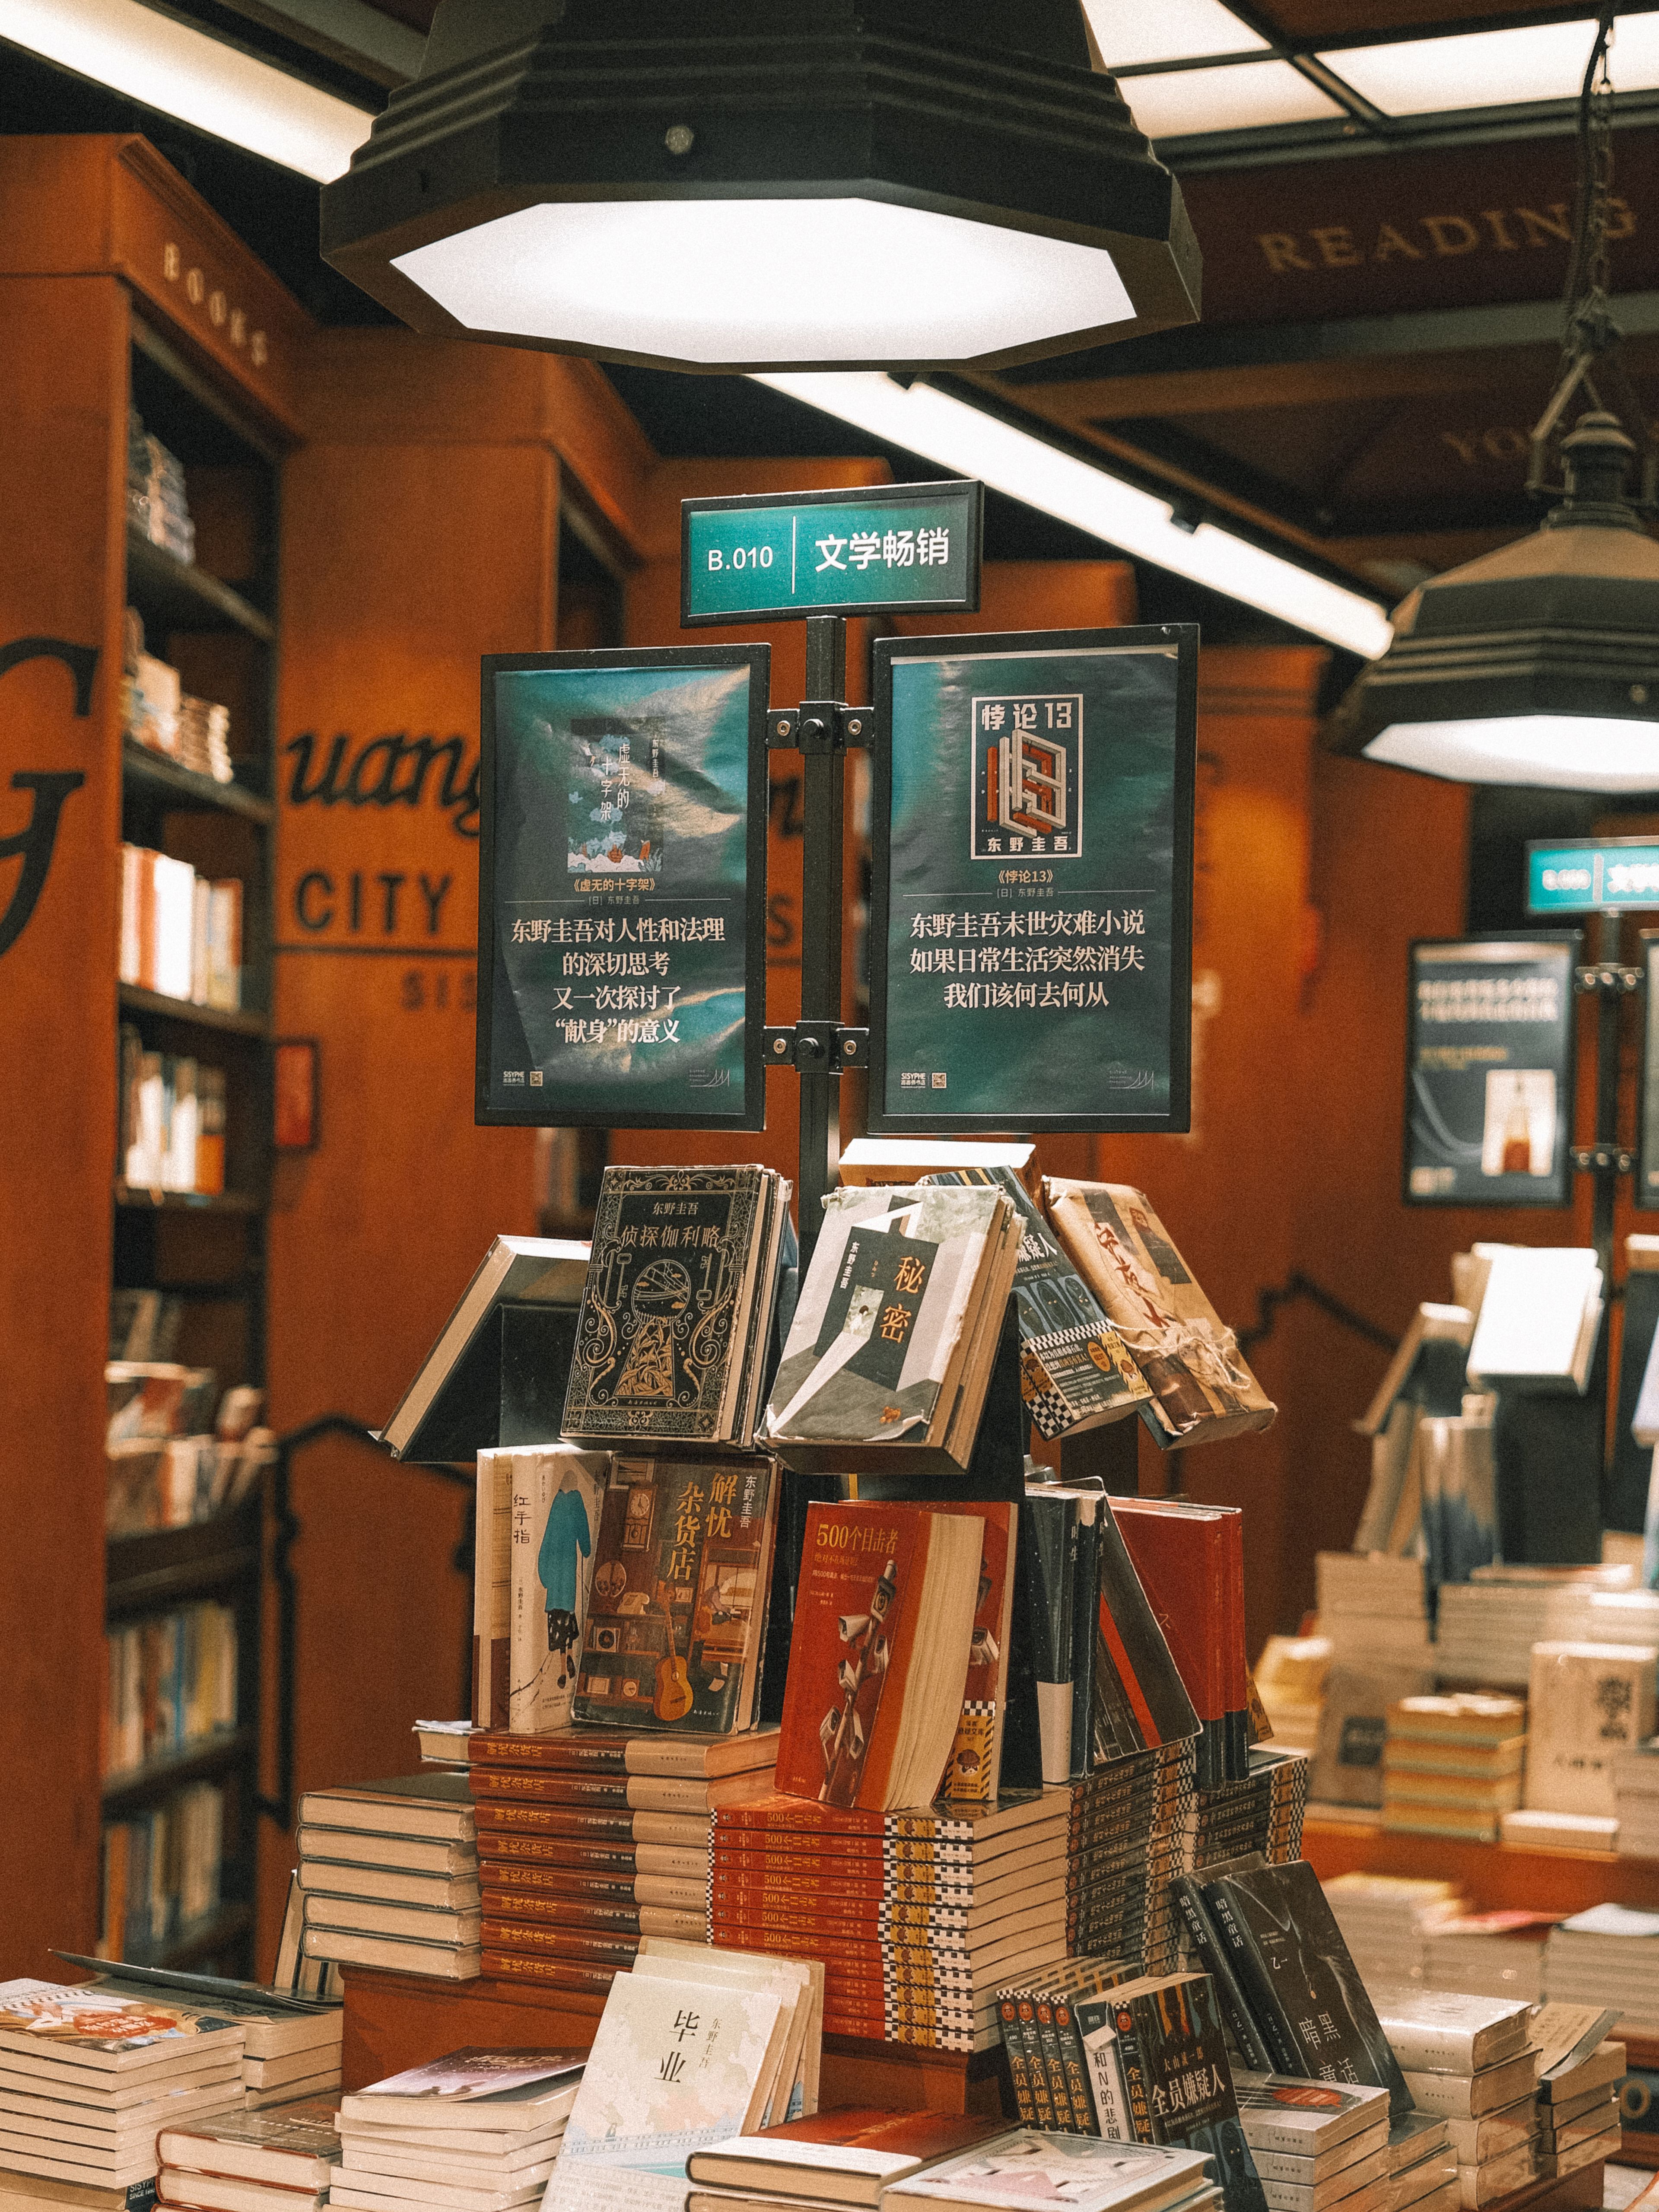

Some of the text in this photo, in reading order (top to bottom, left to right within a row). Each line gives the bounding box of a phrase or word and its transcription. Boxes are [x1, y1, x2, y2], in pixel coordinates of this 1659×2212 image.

[708, 545, 773, 571] B.010
[815, 527, 949, 573] 文学畅销
[600, 756, 613, 821] 十字架
[617, 743, 630, 809] 虚无的
[987, 836, 1068, 852] 东野圭吾
[574, 878, 655, 892] 《虚无的十字架》
[998, 869, 1054, 884] 《悖论13》
[295, 871, 452, 934] CITY
[607, 895, 639, 905] 东野圭吾
[1018, 887, 1054, 898] 东野圭吾
[511, 917, 725, 943] 东野圭吾对人性和法理
[910, 909, 1146, 939] 东野圭吾末世灾难小说
[562, 951, 670, 977] 的深切思考
[910, 945, 1145, 974] 如果日常生活突然消失
[552, 985, 681, 1011] 又一次探讨了
[944, 981, 1109, 1009] 我们该何去何从
[555, 1018, 681, 1044] “献身”的意义
[652, 1201, 699, 1215] 东野圭吾
[621, 1224, 721, 1248] 侦探伽利略
[840, 1241, 860, 1289] 东野圭吾
[880, 1255, 925, 1343] 秘密
[706, 1472, 738, 1538] 解忧
[739, 1475, 757, 1529] 东野圭吾
[513, 1494, 532, 1544] 红手指
[667, 1482, 704, 1580] 杂货店
[816, 1523, 899, 1554] 500个目击者
[1179, 1894, 1207, 1944] 暗黑童话
[1215, 1898, 1243, 1947] 暗黑童话
[1270, 1957, 1288, 1970] 乙一
[654, 2009, 700, 2083] 毕业
[699, 2017, 722, 2069] 东野圭吾
[1151, 2064, 1225, 2117] 全员嫌疑人
[129, 2190, 144, 2200] SINCE
